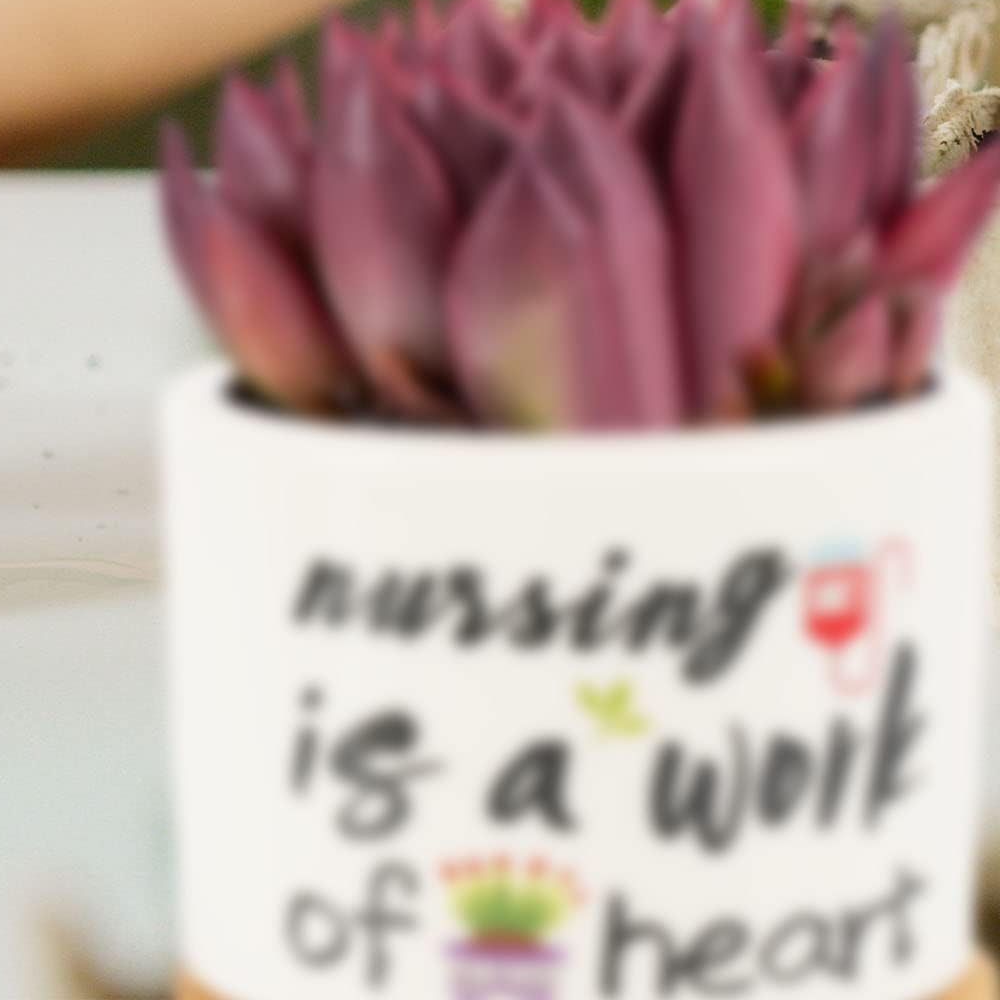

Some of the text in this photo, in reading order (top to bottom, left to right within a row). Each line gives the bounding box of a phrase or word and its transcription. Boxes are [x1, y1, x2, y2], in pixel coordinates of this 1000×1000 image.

[291, 545, 791, 688] nursing
[292, 640, 925, 857] is a work
[286, 862, 924, 999] of heart
